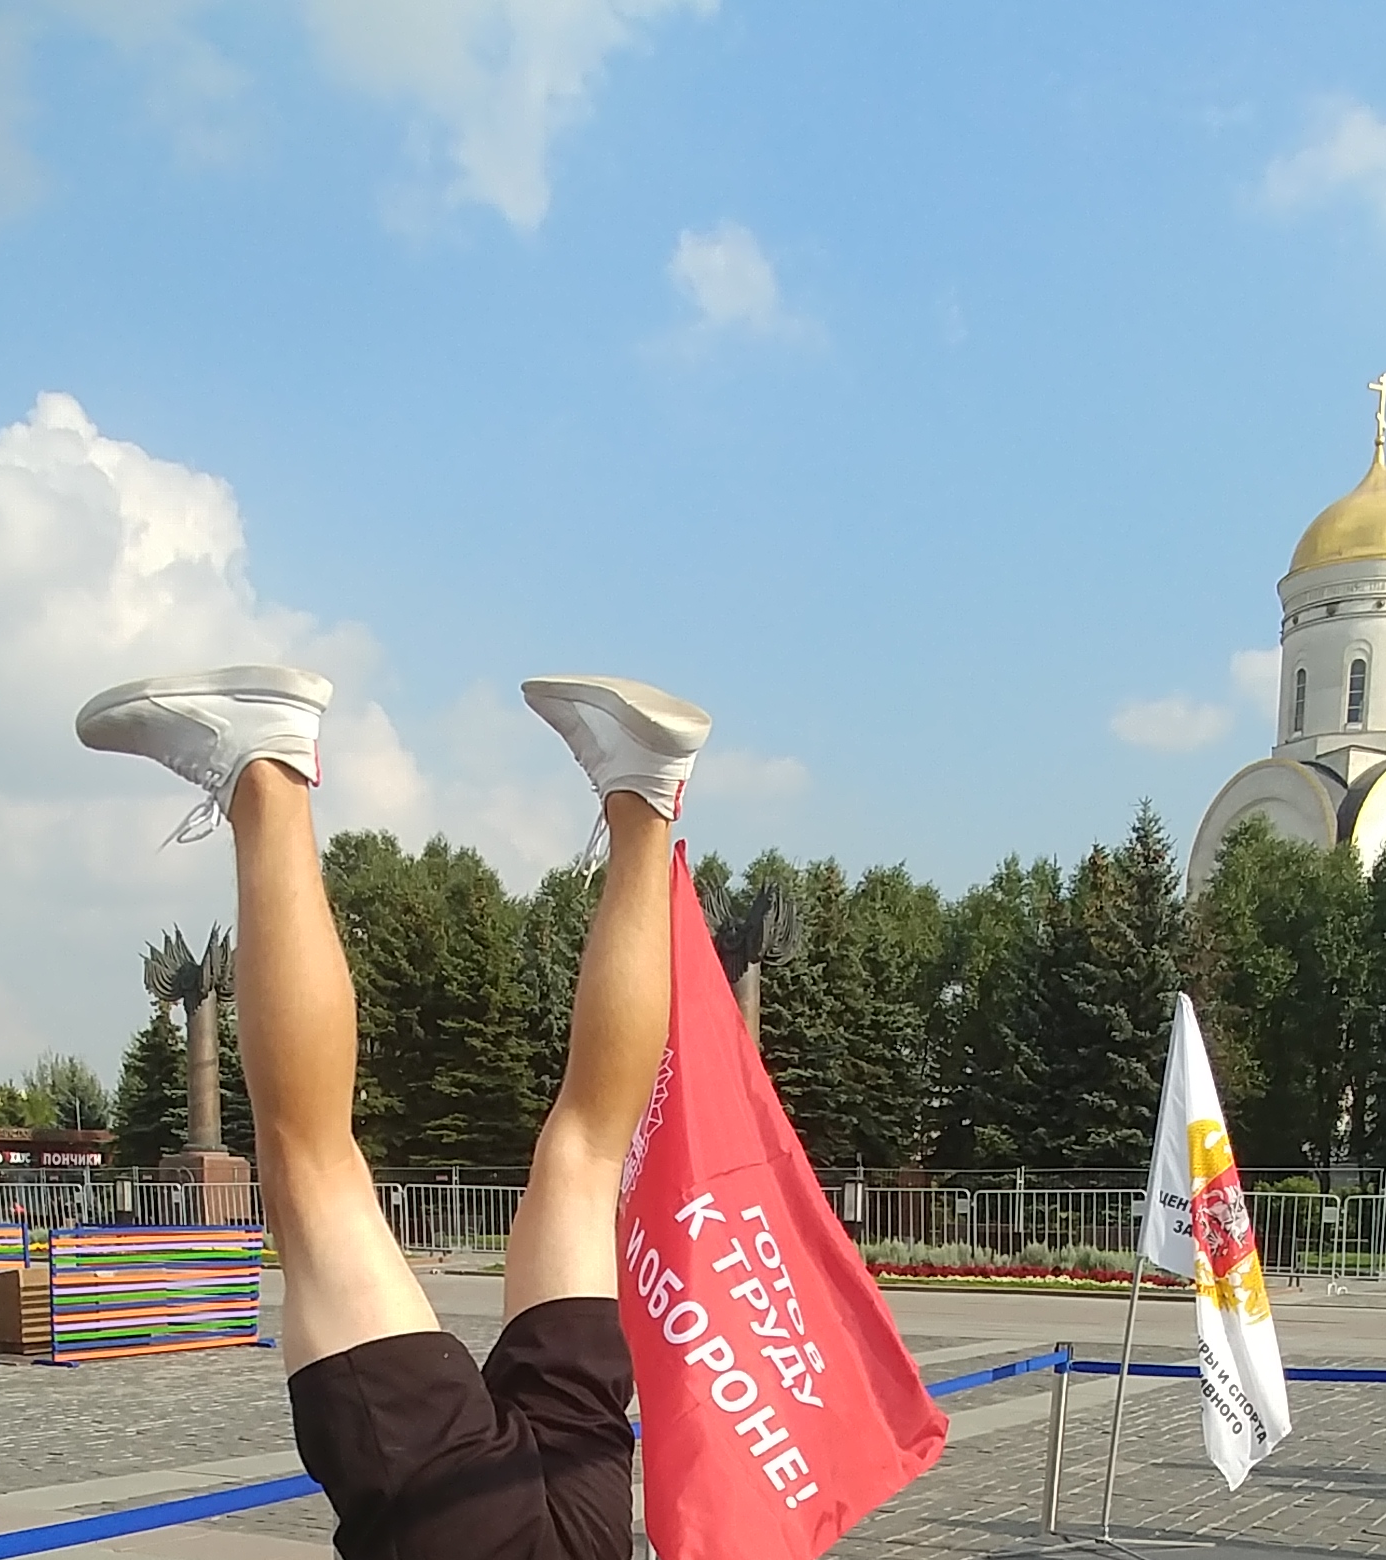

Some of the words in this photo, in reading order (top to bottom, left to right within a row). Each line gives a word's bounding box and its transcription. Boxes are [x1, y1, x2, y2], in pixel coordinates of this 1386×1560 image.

[42, 1151, 102, 1165] ПОНЧИКИ
[1159, 1189, 1192, 1213] ЦЕН
[674, 1192, 727, 1241] К
[712, 1237, 824, 1408] ТРУДУ
[740, 1205, 826, 1374] ГОТОВ
[625, 1216, 645, 1273] И
[637, 1248, 819, 1510] ОБОРОНЕ!
[1217, 1369, 1230, 1385] И
[1228, 1384, 1267, 1445] СПОРТА
